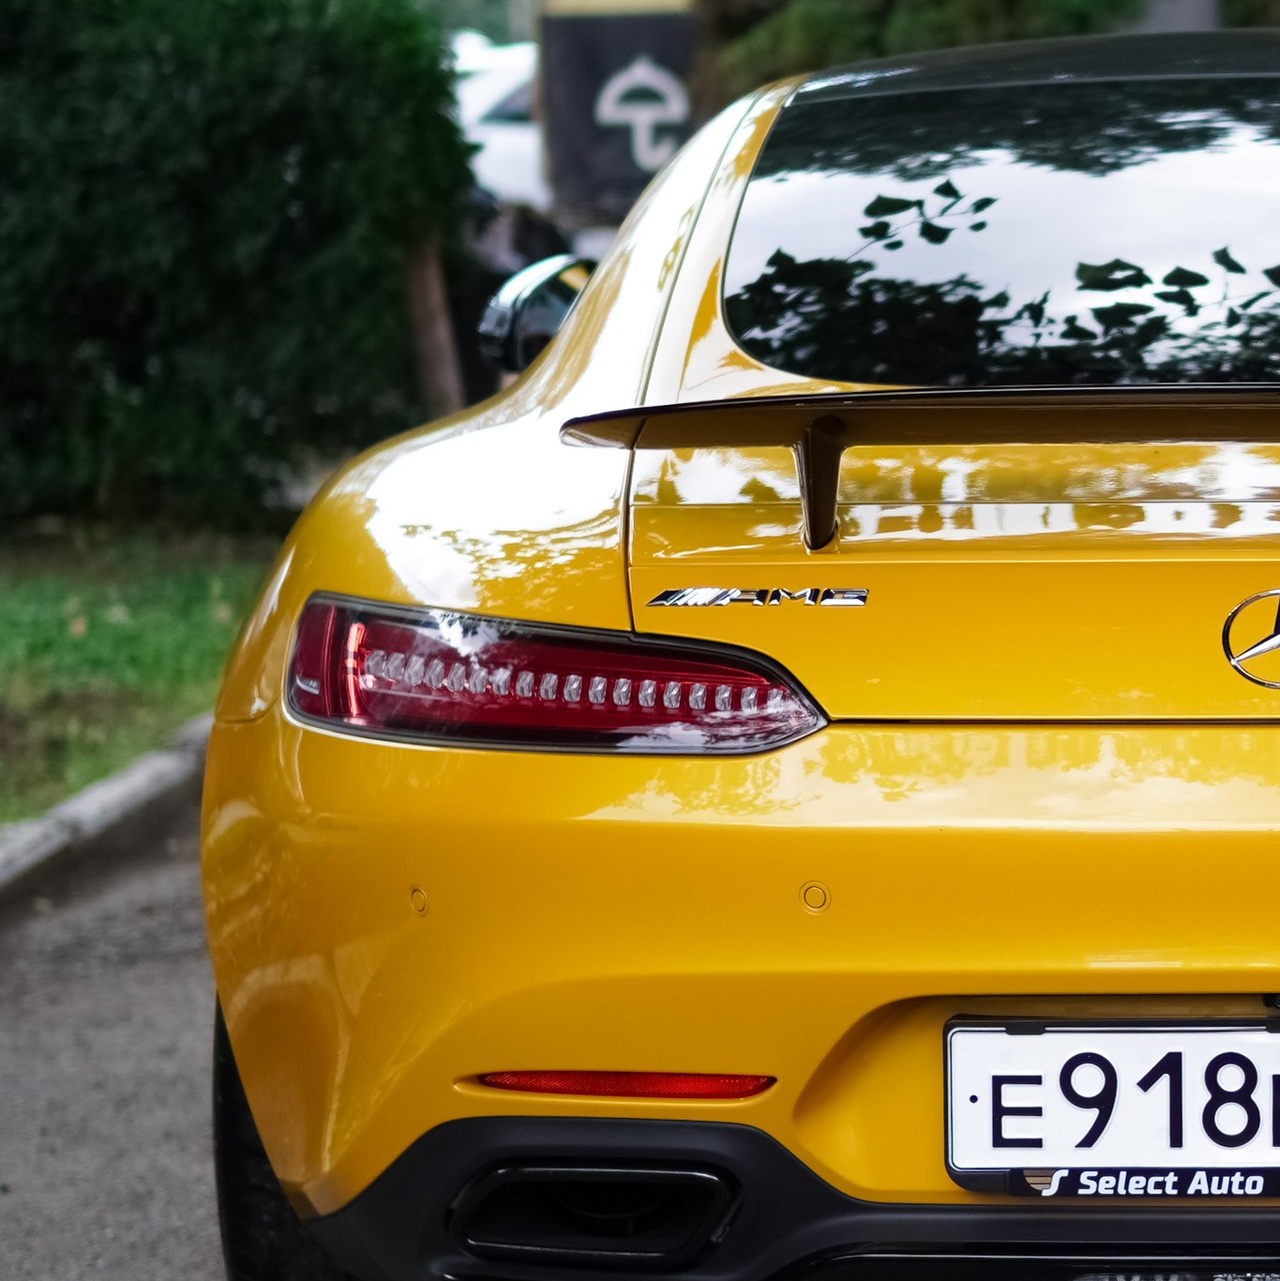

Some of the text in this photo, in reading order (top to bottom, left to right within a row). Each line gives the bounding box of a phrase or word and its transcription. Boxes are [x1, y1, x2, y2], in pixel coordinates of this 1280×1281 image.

[708, 586, 870, 607] AMG
[1077, 1170, 1179, 1195] Select
[1187, 1170, 1264, 1195] Auto
